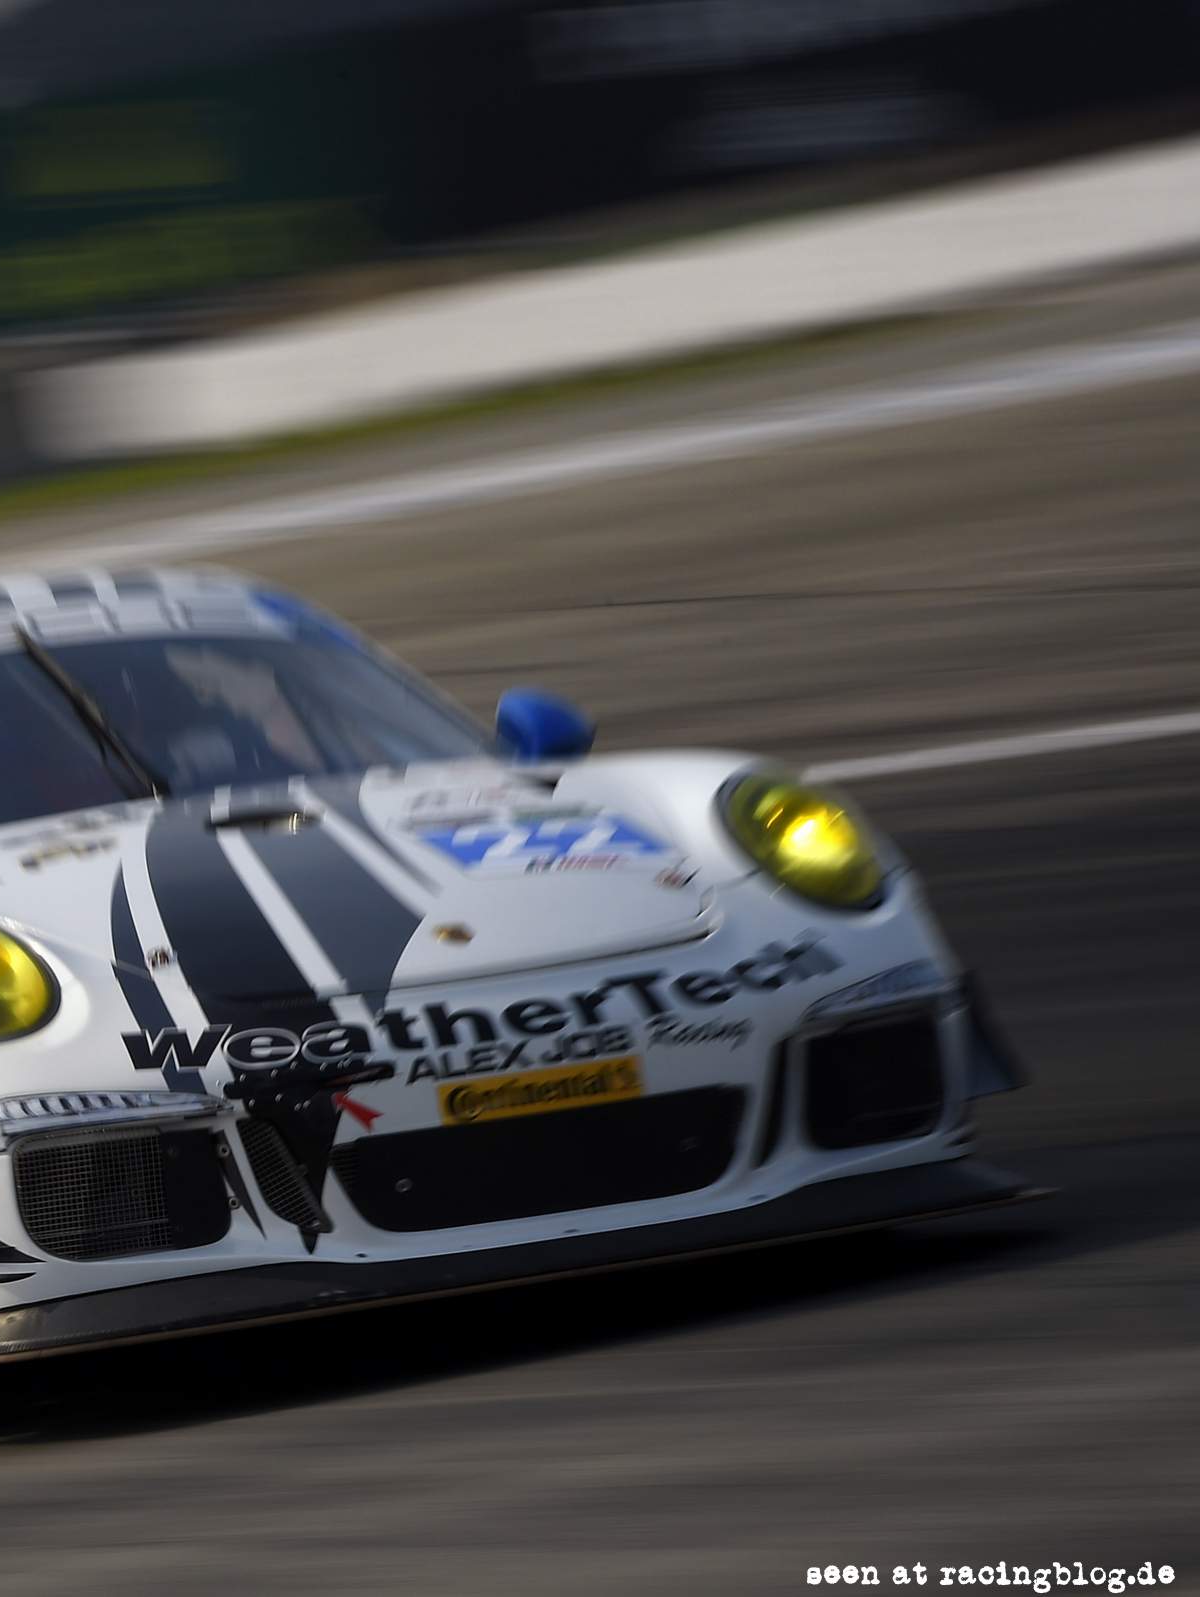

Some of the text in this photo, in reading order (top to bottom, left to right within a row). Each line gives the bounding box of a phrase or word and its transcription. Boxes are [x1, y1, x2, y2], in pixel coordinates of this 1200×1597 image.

[120, 926, 845, 1071] WeatherTech
[405, 1038, 534, 1086] ALEX
[539, 1023, 634, 1062] JOB
